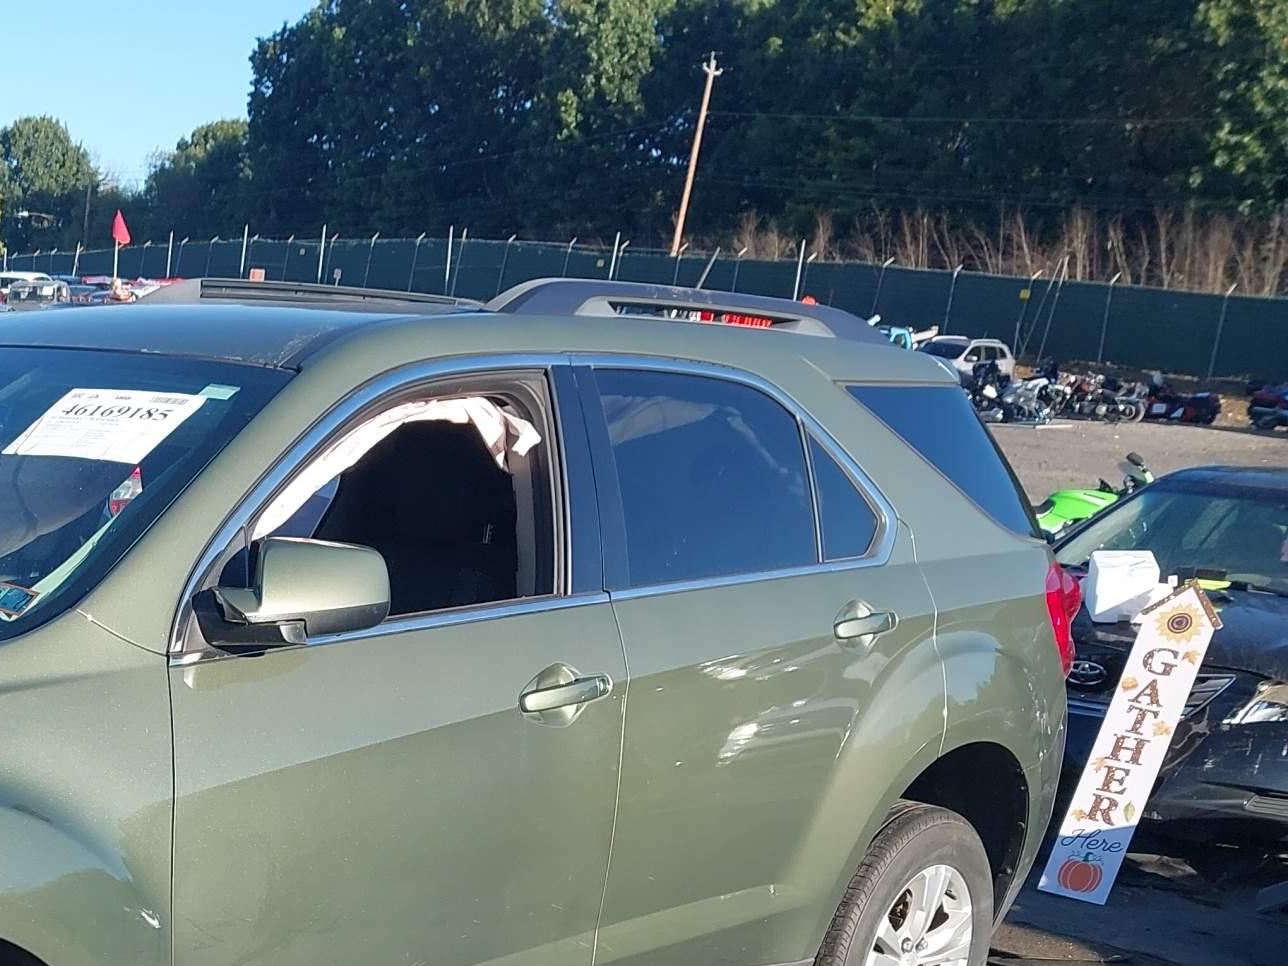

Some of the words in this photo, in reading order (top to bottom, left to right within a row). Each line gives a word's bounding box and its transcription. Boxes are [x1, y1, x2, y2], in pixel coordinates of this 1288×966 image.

[61, 403, 174, 421] 46169185
[1086, 647, 1180, 826] GATHER
[1061, 828, 1123, 853] Here
